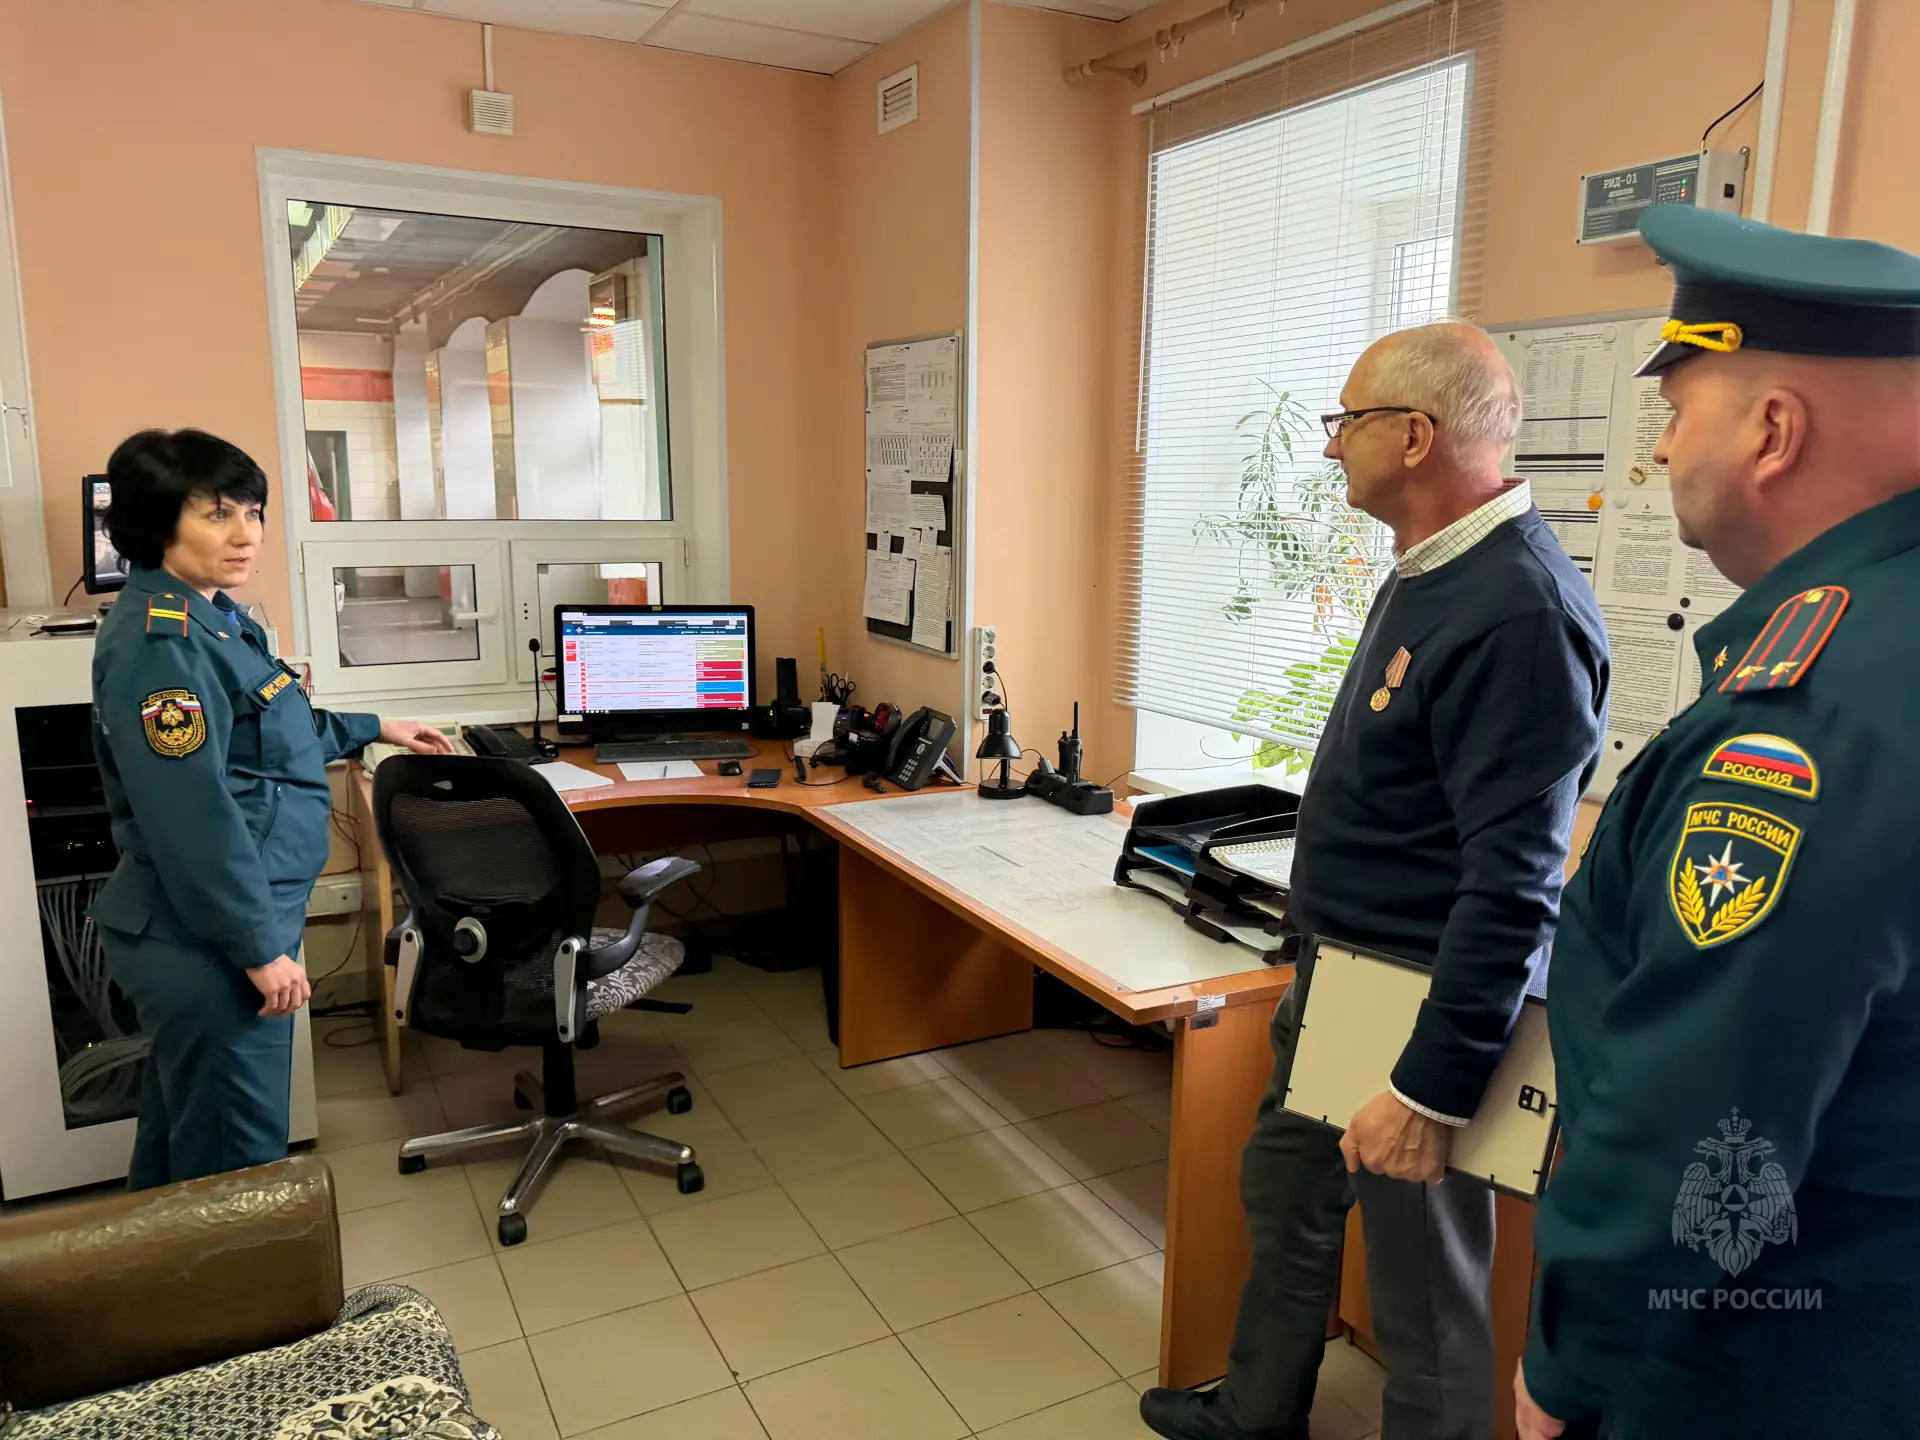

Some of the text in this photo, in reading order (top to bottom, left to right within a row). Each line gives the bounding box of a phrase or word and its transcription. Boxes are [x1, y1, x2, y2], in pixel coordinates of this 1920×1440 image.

[1603, 172, 1638, 189] РИД-01
[1722, 761, 1794, 786] РОССИЯ
[1689, 809, 1791, 848] МЧС РОССИИ
